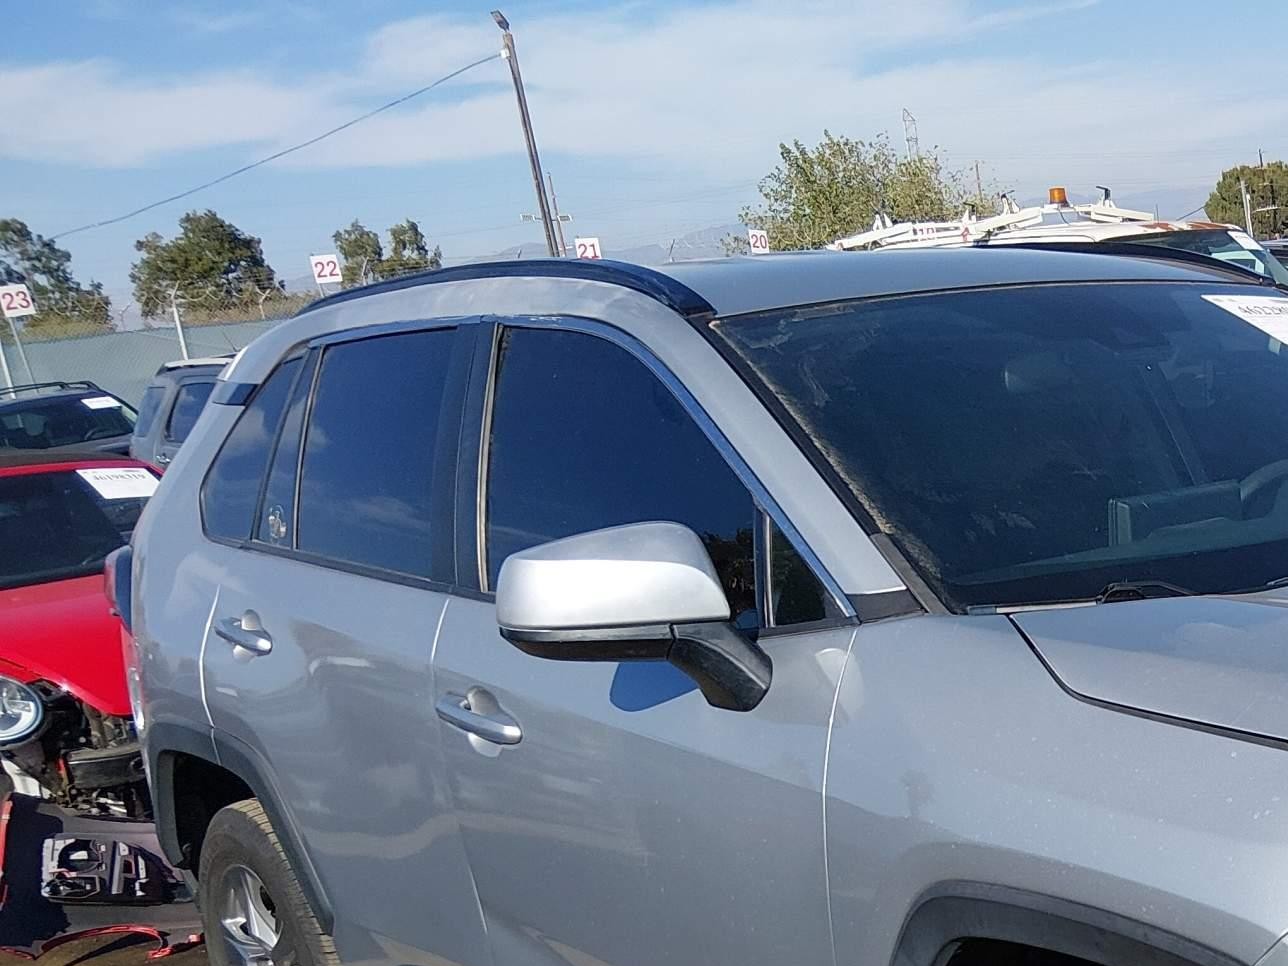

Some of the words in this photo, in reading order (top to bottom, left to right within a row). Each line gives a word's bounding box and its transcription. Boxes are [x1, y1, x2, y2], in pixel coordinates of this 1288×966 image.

[751, 234, 767, 249] 20
[578, 243, 600, 259] 21
[315, 260, 340, 278] 22
[2, 291, 31, 310] 23
